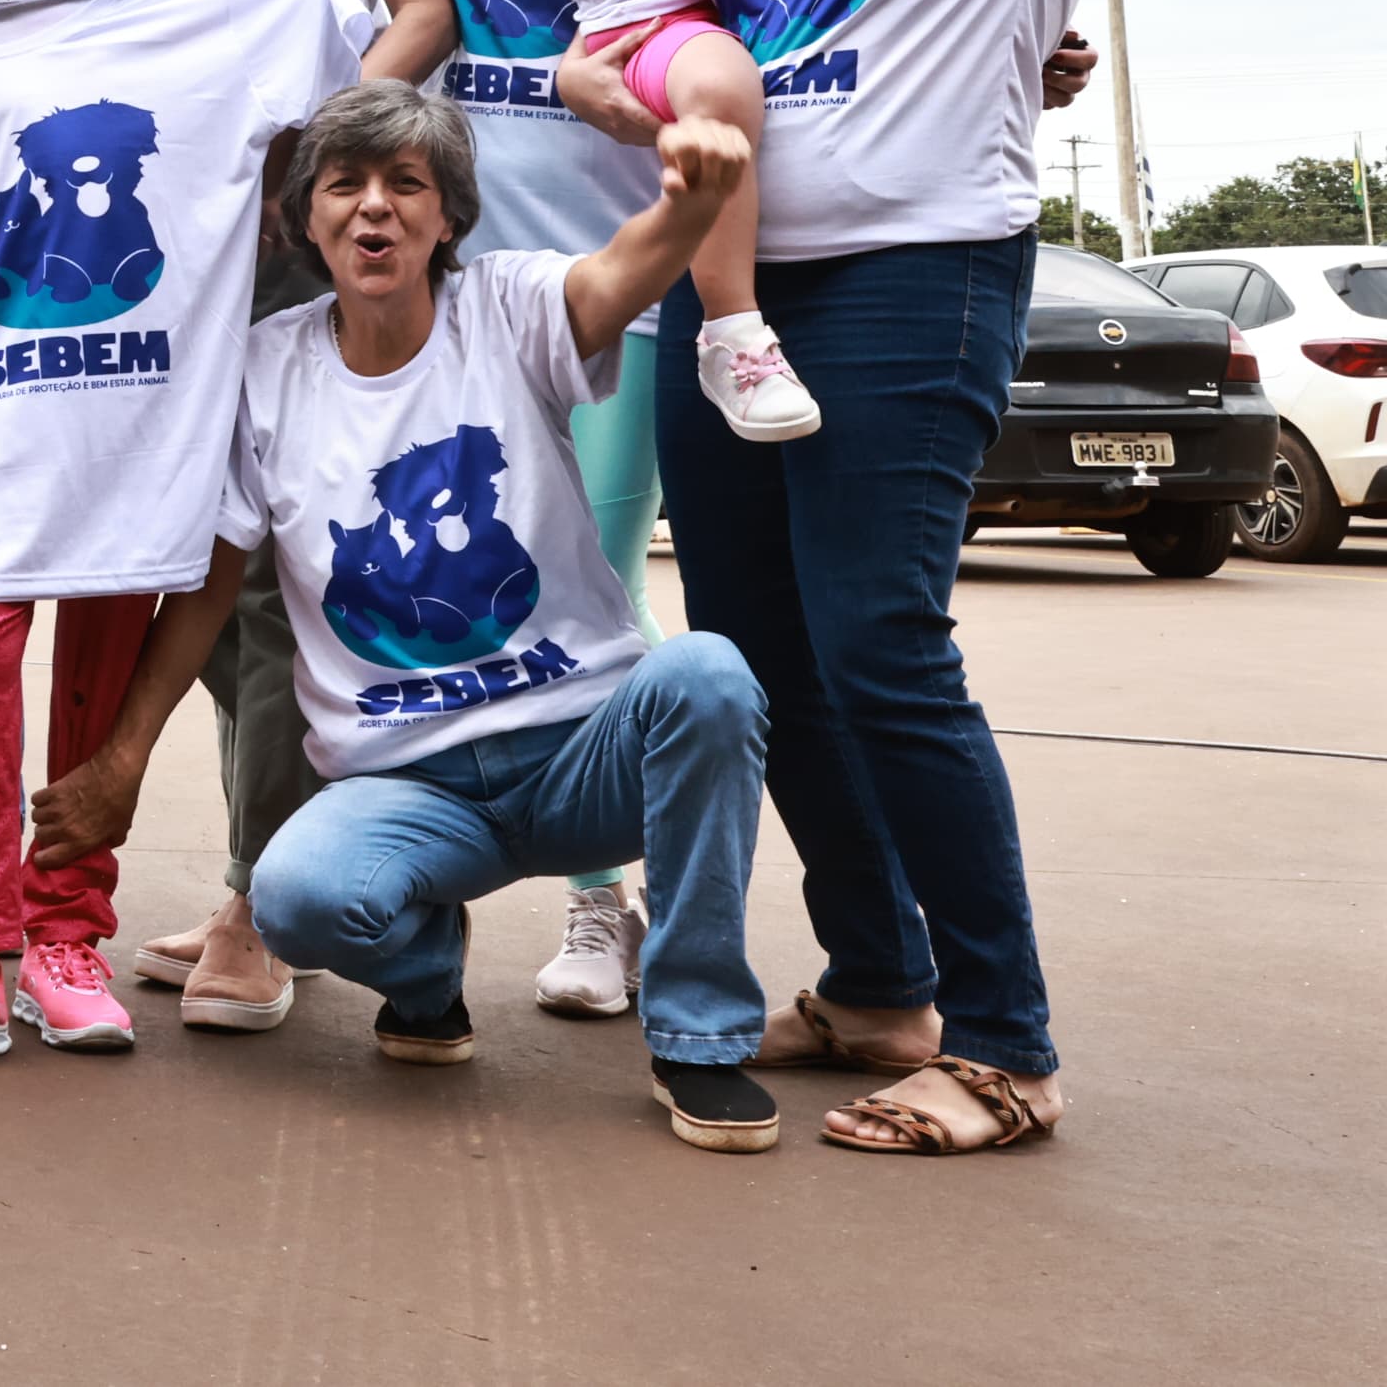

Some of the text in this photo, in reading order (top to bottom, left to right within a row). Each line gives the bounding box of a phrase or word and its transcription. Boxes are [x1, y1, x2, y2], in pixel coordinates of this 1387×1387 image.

[774, 99, 808, 110] ESTAR
[810, 96, 852, 107] ANIMAL
[505, 109, 512, 117] E
[513, 109, 534, 119] BEM
[535, 111, 566, 122] ESTAR
[15, 388, 28, 396] DE
[28, 380, 82, 394] PROTEÇÃO
[83, 381, 89, 390] E
[91, 379, 108, 390] BEM
[109, 377, 136, 388] ESTAR
[137, 375, 170, 386] ANIMAL
[355, 637, 580, 717] SEBEM
